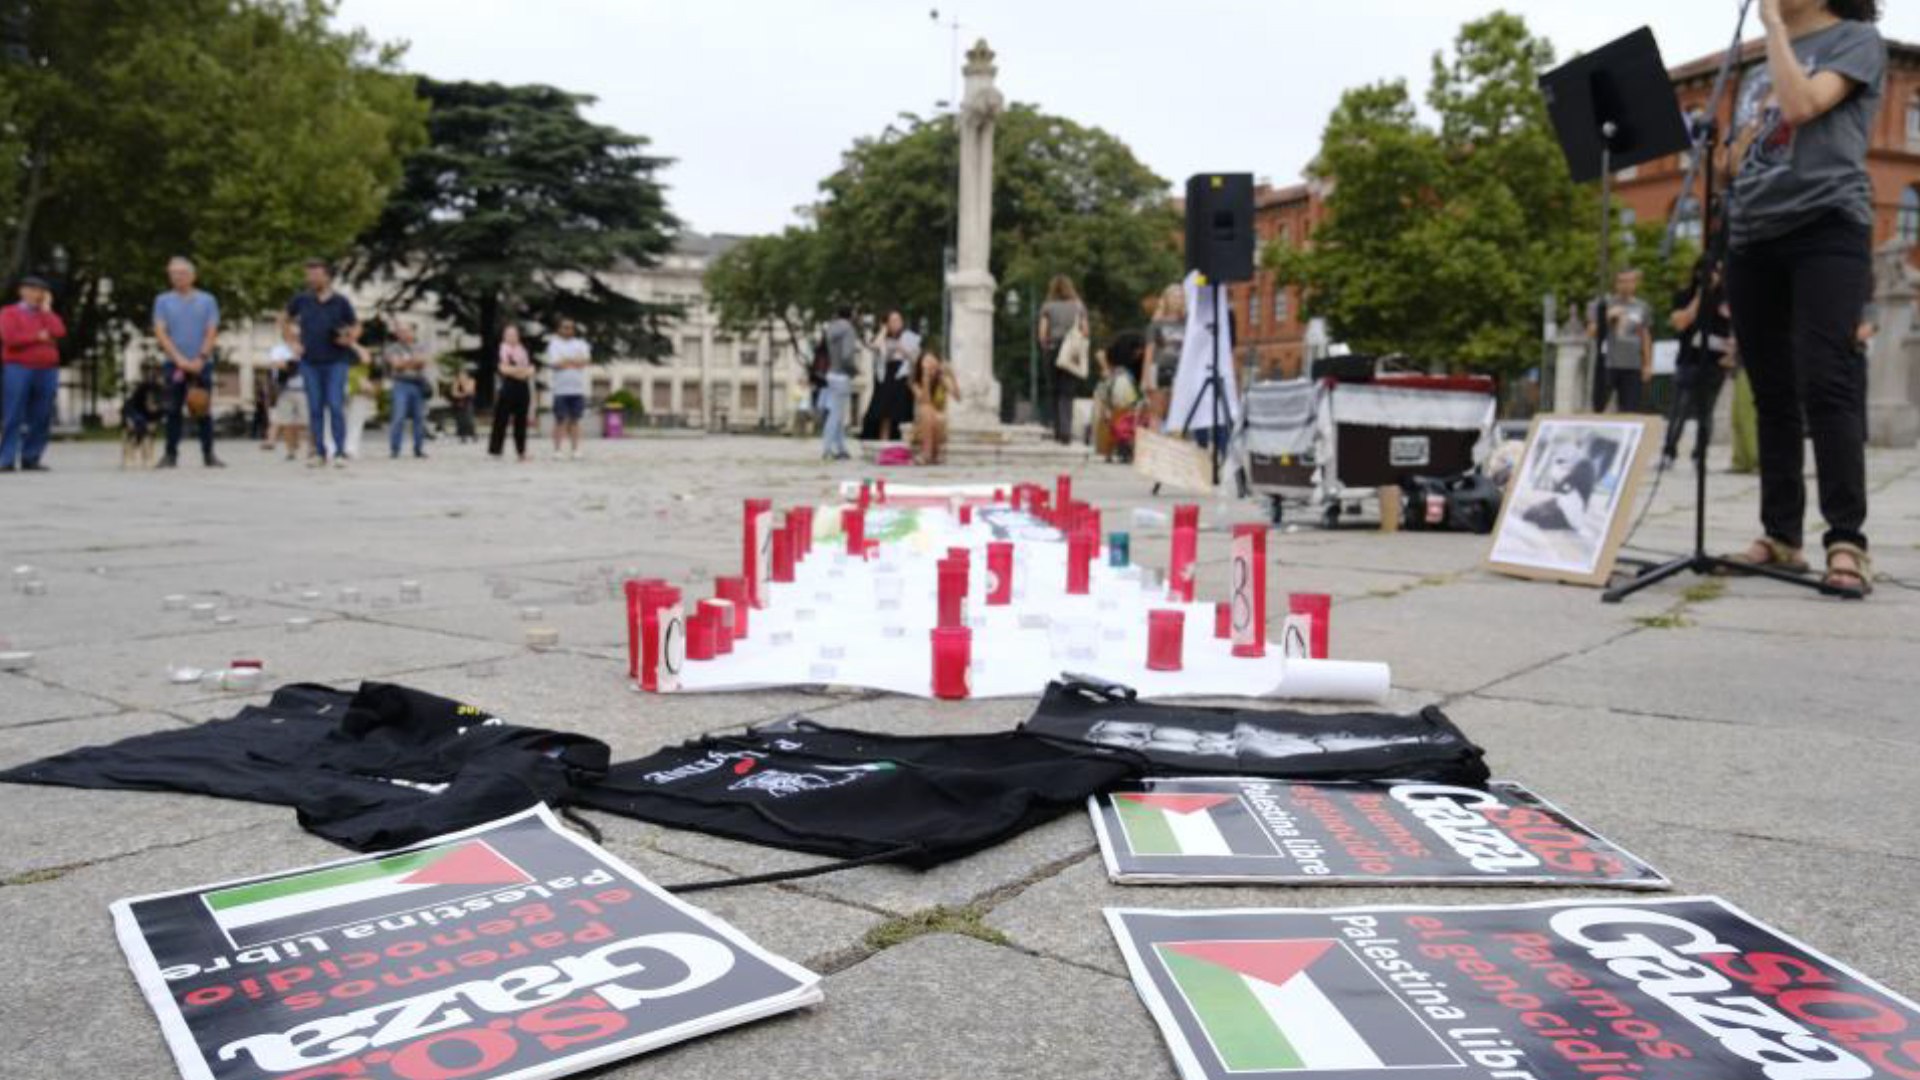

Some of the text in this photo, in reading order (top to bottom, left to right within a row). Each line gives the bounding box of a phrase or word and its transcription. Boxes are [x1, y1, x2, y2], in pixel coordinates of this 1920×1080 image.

[1238, 783, 1330, 874] Palestina Libre
[1345, 793, 1431, 856] Paremos
[1389, 785, 1540, 873] Gaza
[161, 869, 616, 981] Palestina Libre
[185, 887, 634, 1006] el genocidio
[282, 920, 615, 1011] Paremos
[216, 932, 736, 1073] Gaza
[1331, 915, 1538, 1080] Palestina Libr
[1405, 915, 1645, 1080] el genocidi
[1491, 931, 1692, 1060] Paremos
[1549, 906, 1874, 1080] Gaza
